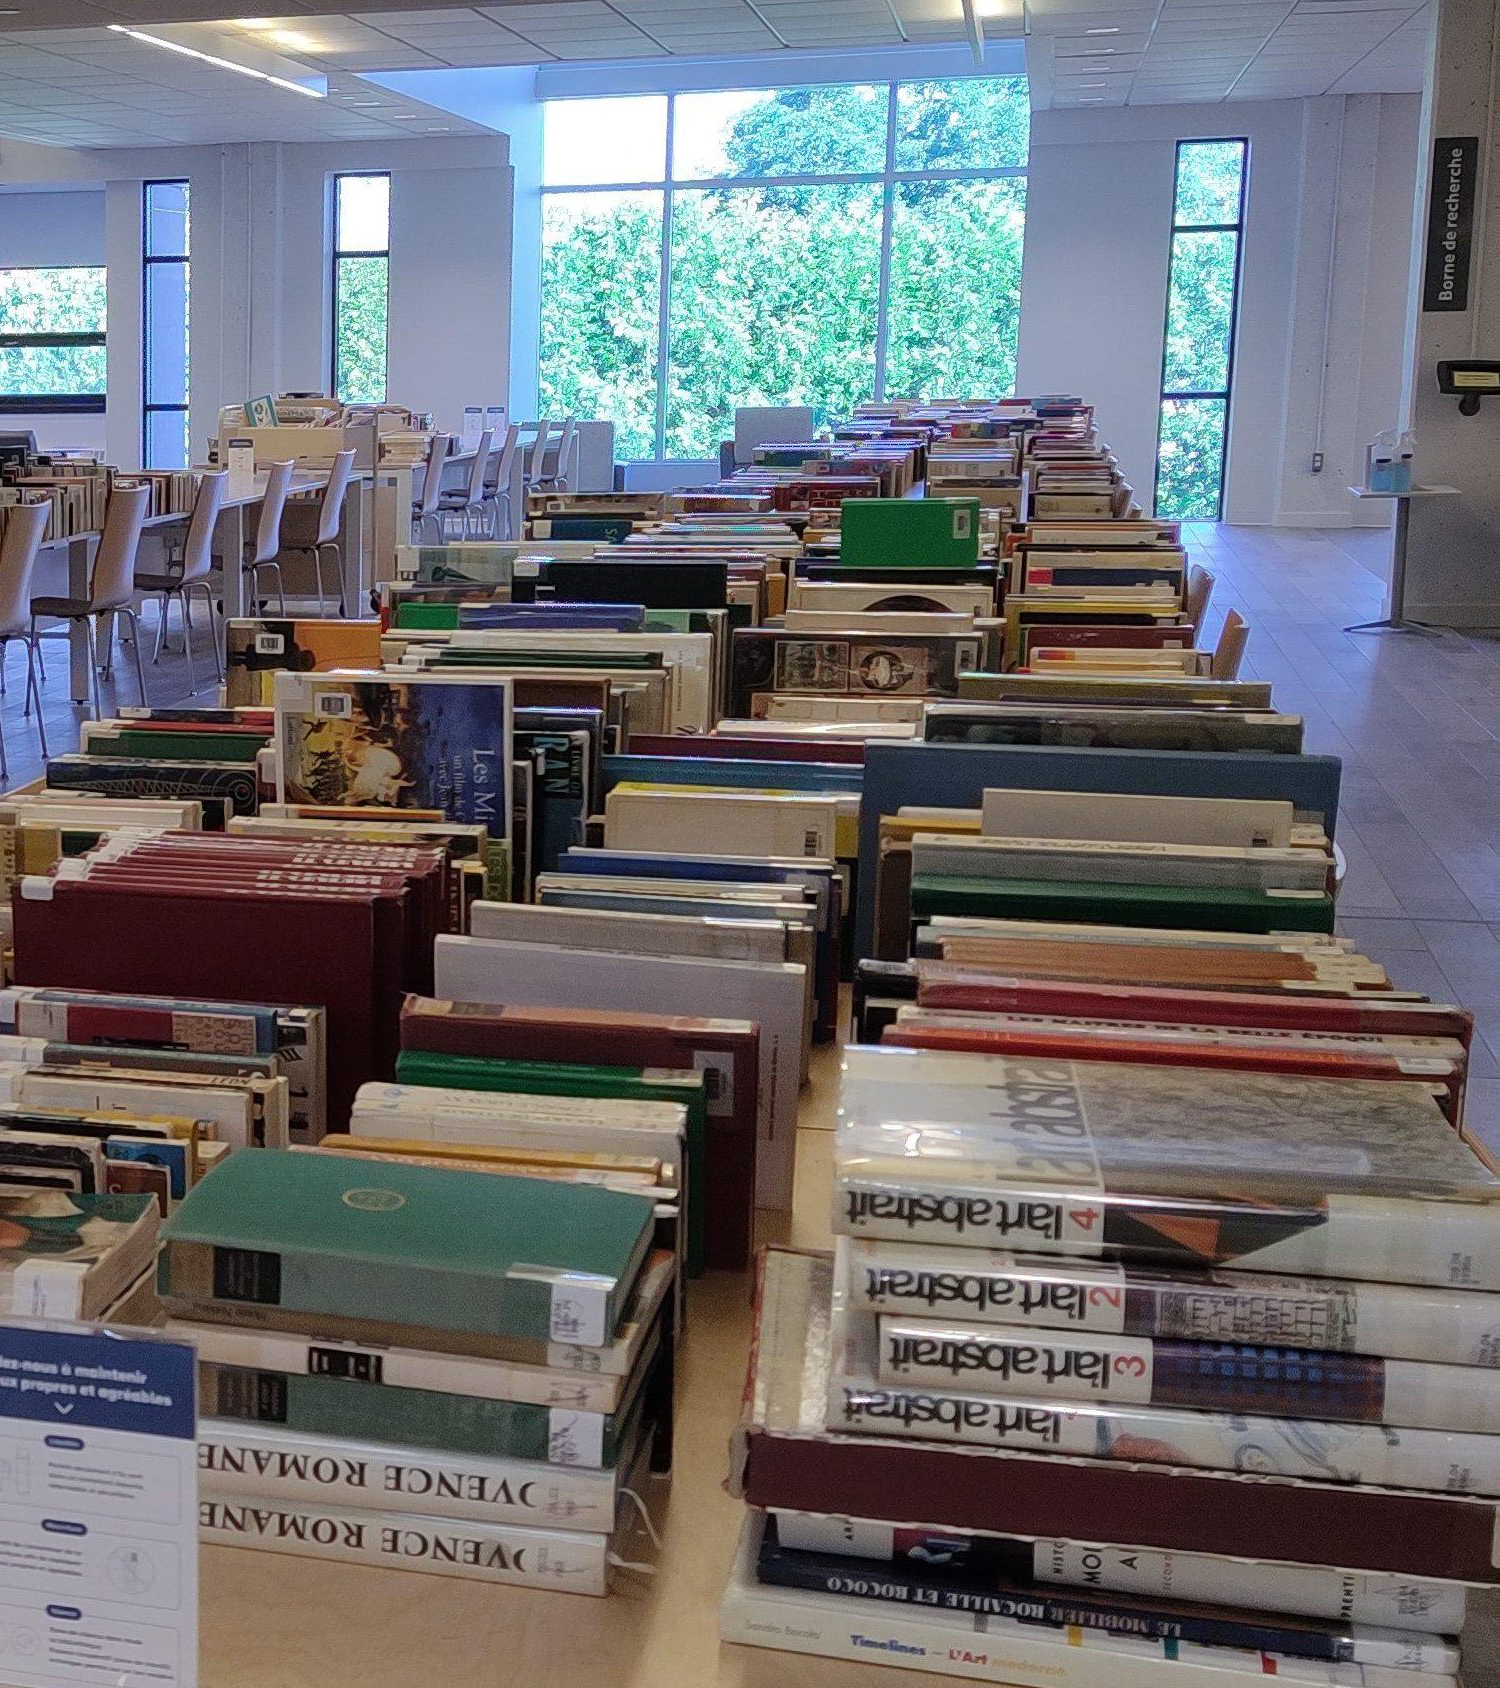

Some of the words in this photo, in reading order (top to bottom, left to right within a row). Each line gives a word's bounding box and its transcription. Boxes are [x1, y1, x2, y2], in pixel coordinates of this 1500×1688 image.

[1445, 147, 1463, 228] recherche
[1442, 231, 1457, 251] de
[1438, 254, 1456, 301] Borne
[473, 750, 495, 784] Les
[846, 1190, 995, 1233] abstrait
[996, 1200, 1064, 1241] l'art
[1069, 1207, 1100, 1230] 4
[865, 1267, 1018, 1311] abstrait
[1019, 1280, 1086, 1321] l'art
[61, 1363, 72, 1376] à
[75, 1366, 147, 1385] maintenir
[888, 1337, 1041, 1381] abstrait
[1043, 1349, 1110, 1389] l'art
[1113, 1355, 1145, 1378] 3
[20, 1378, 76, 1396] propres
[80, 1384, 95, 1397] et
[98, 1386, 173, 1407] agréables
[842, 1388, 992, 1432] abstrait
[994, 1403, 1061, 1443] l'art
[198, 1443, 368, 1488] ROMANE
[199, 1501, 366, 1550] ROMANE
[827, 1577, 908, 1600] ROCOCO
[917, 1588, 938, 1604] ET
[947, 1592, 1044, 1619] ROCAILLE
[1050, 1607, 1149, 1633] MOBILIER
[1159, 1621, 1181, 1638] LE
[851, 1635, 926, 1656] Timelines
